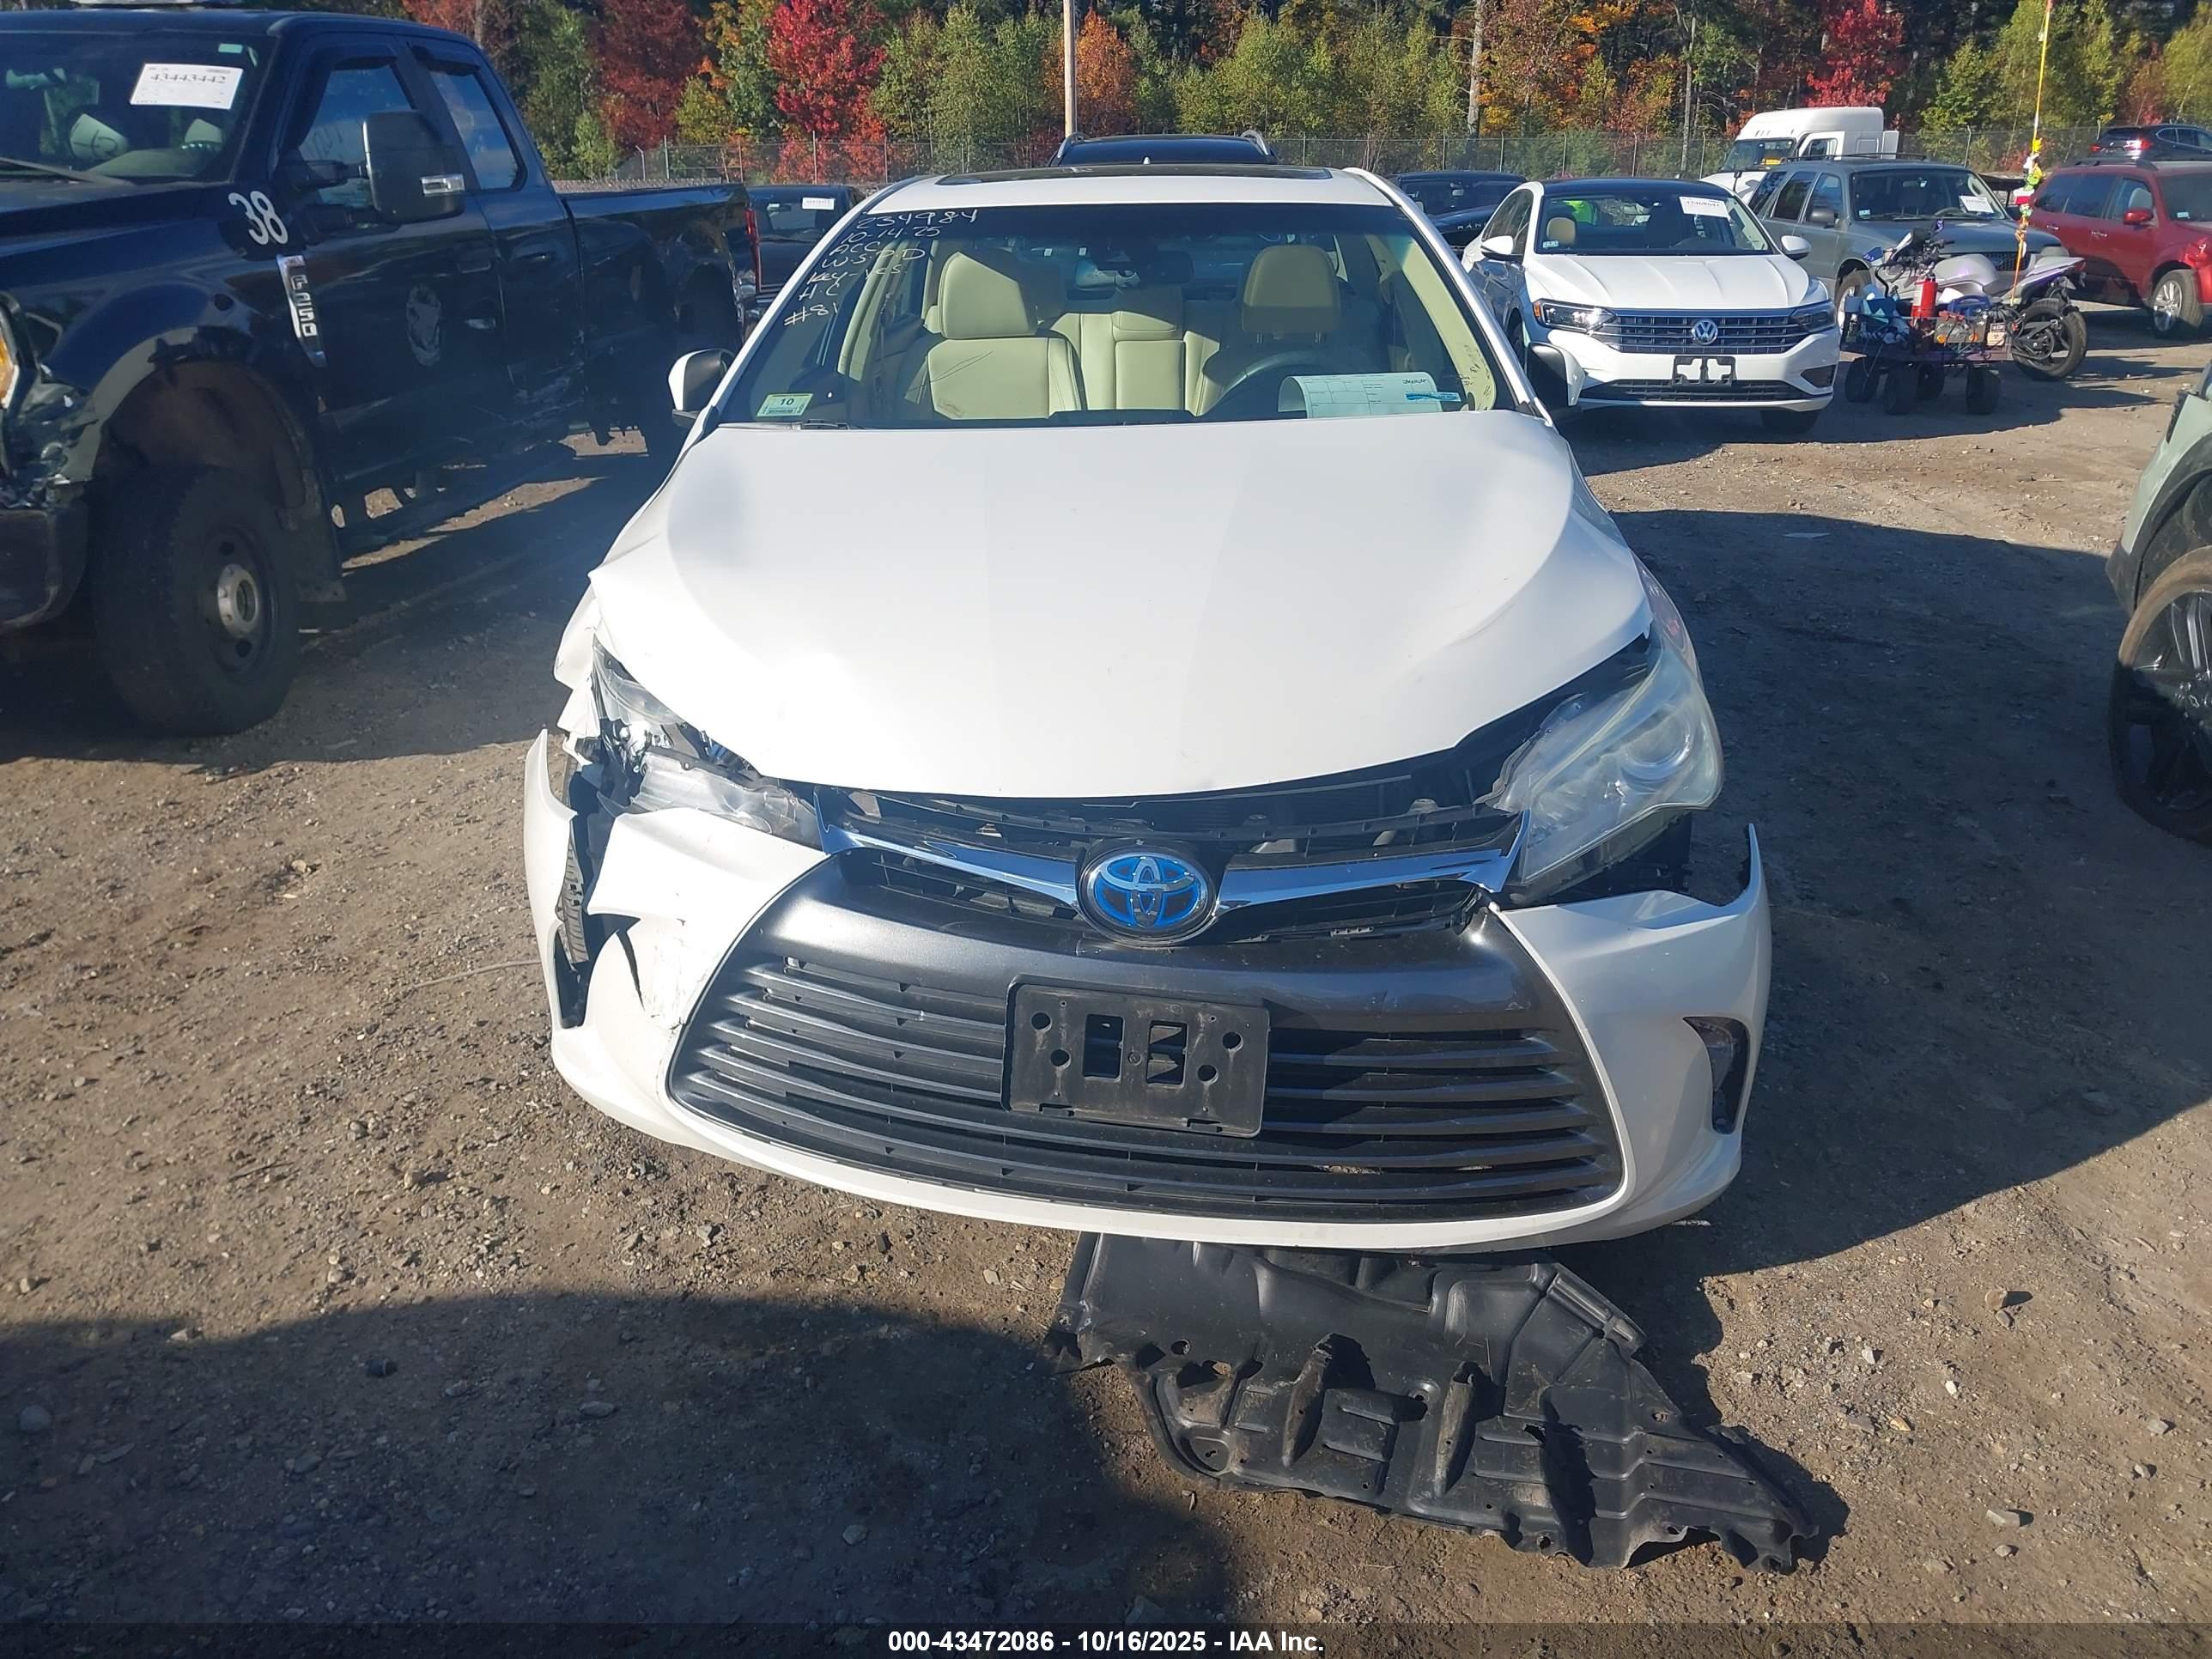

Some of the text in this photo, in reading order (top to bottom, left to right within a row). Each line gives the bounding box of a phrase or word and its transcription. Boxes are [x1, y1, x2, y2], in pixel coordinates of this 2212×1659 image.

[228, 191, 289, 245] 38
[829, 241, 880, 257] ACC
[780, 398, 794, 406] 10
